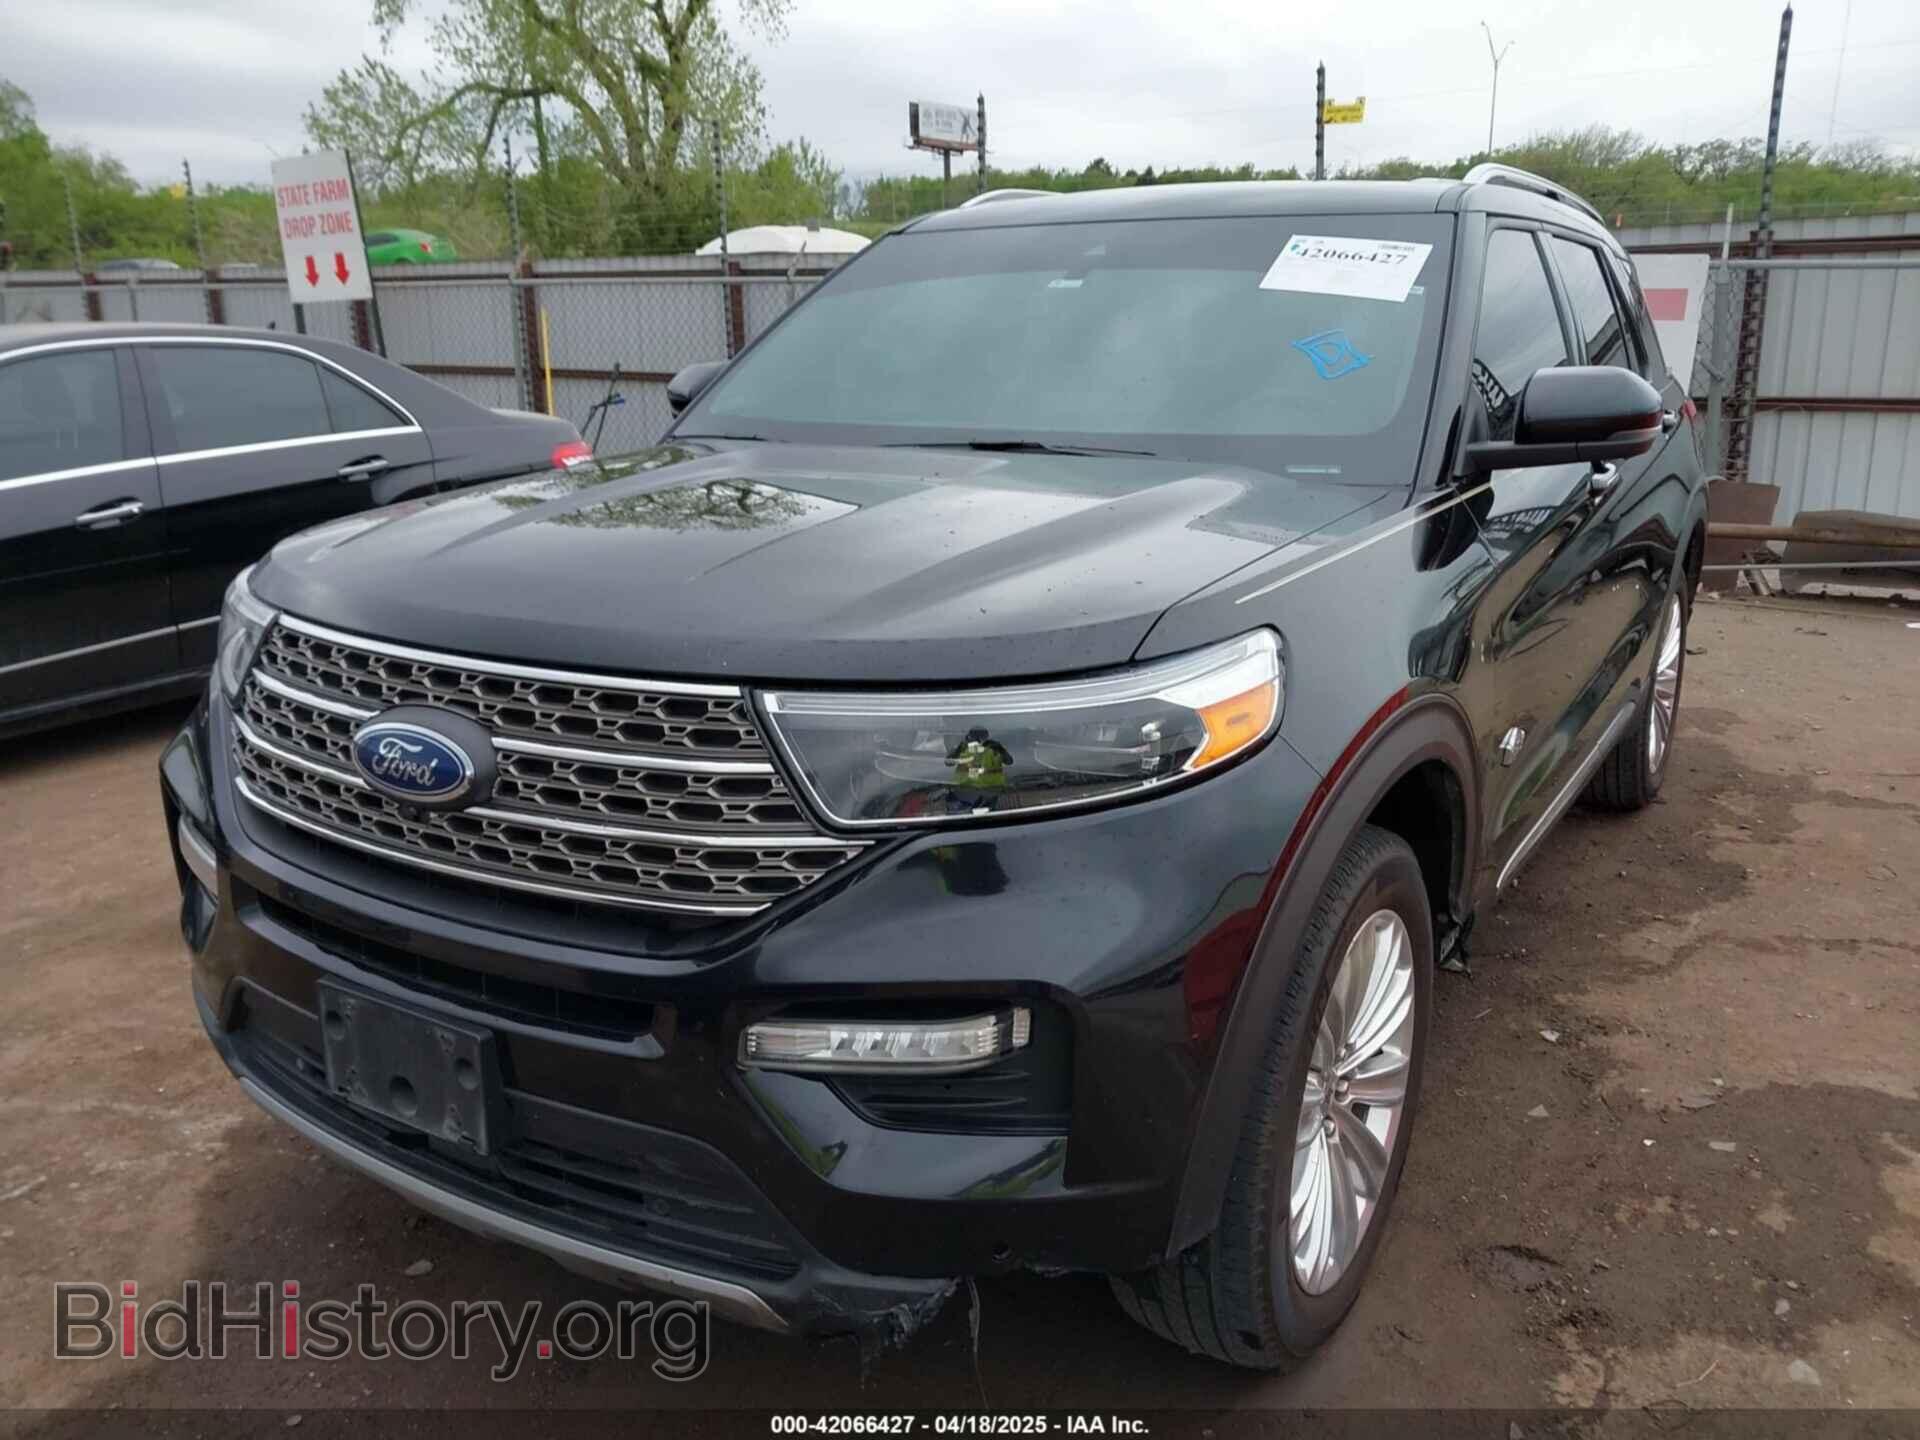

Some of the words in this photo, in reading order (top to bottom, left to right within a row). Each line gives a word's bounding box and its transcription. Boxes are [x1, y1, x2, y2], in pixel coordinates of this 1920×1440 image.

[277, 183, 310, 208] STATE
[313, 177, 350, 204] FARM
[283, 216, 316, 239] DROP
[319, 211, 353, 235] ZONE
[1297, 247, 1408, 265] 42066427
[371, 737, 439, 786] Ford
